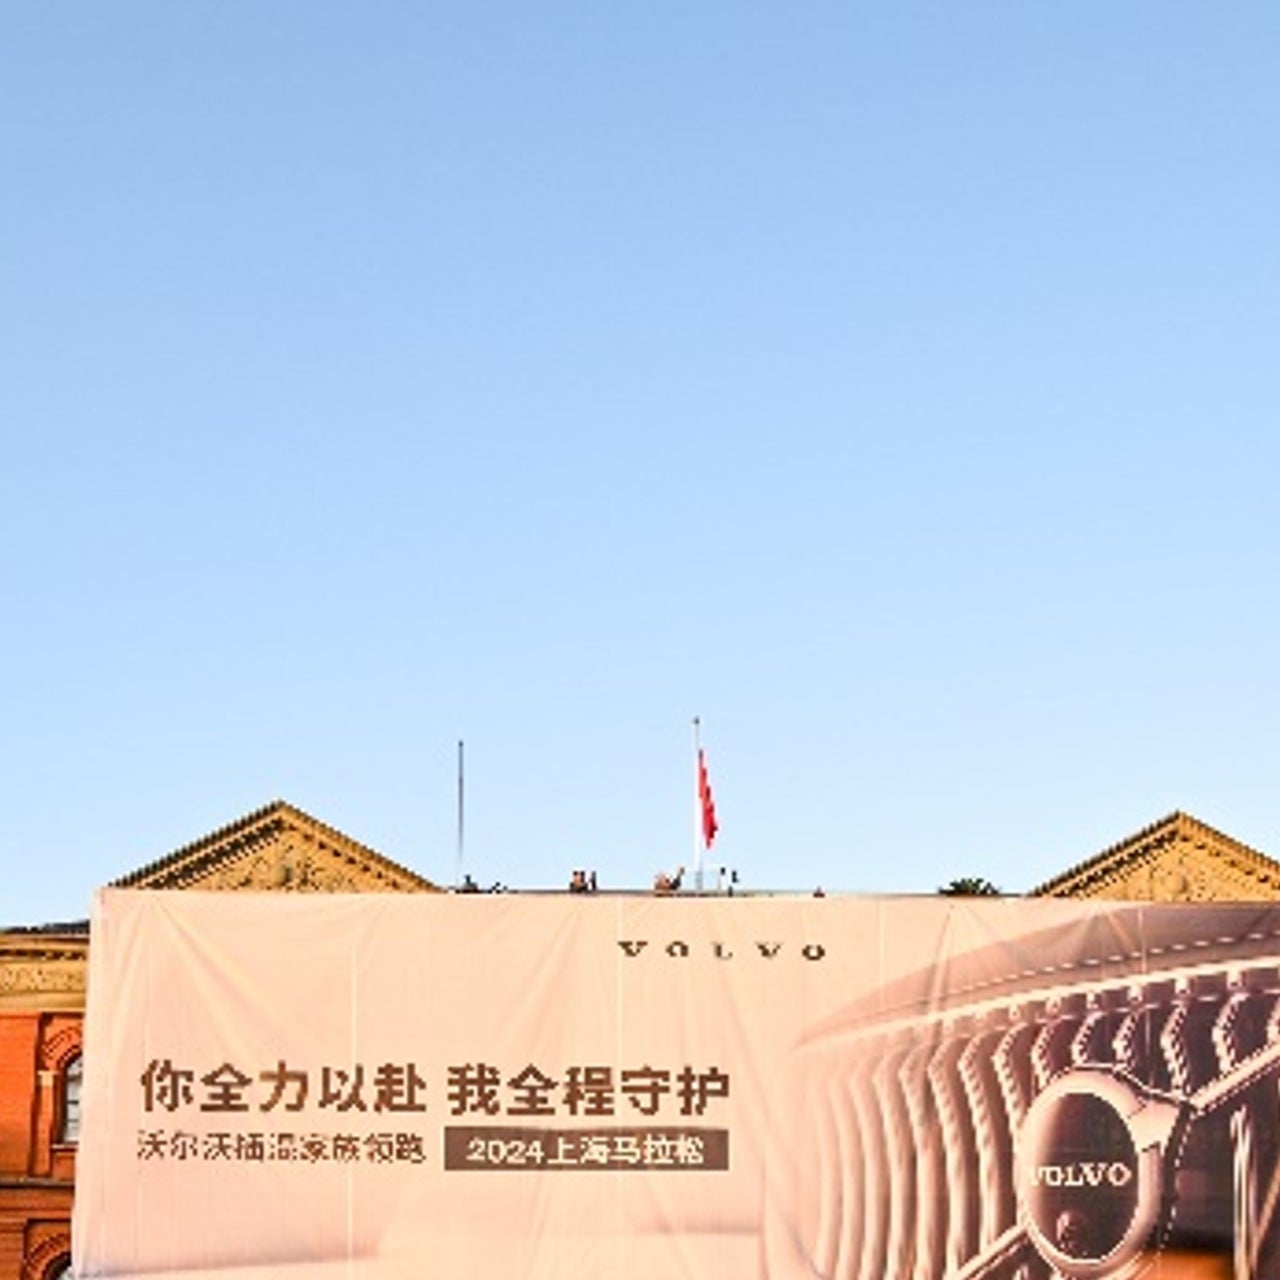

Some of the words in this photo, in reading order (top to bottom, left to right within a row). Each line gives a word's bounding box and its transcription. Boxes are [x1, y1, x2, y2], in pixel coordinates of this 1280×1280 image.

[618, 940, 826, 961] VOLVO
[140, 1059, 427, 1112] 你全力以赴
[447, 1063, 730, 1116] 我全程守护
[466, 1133, 705, 1165] 2024上海马拉松
